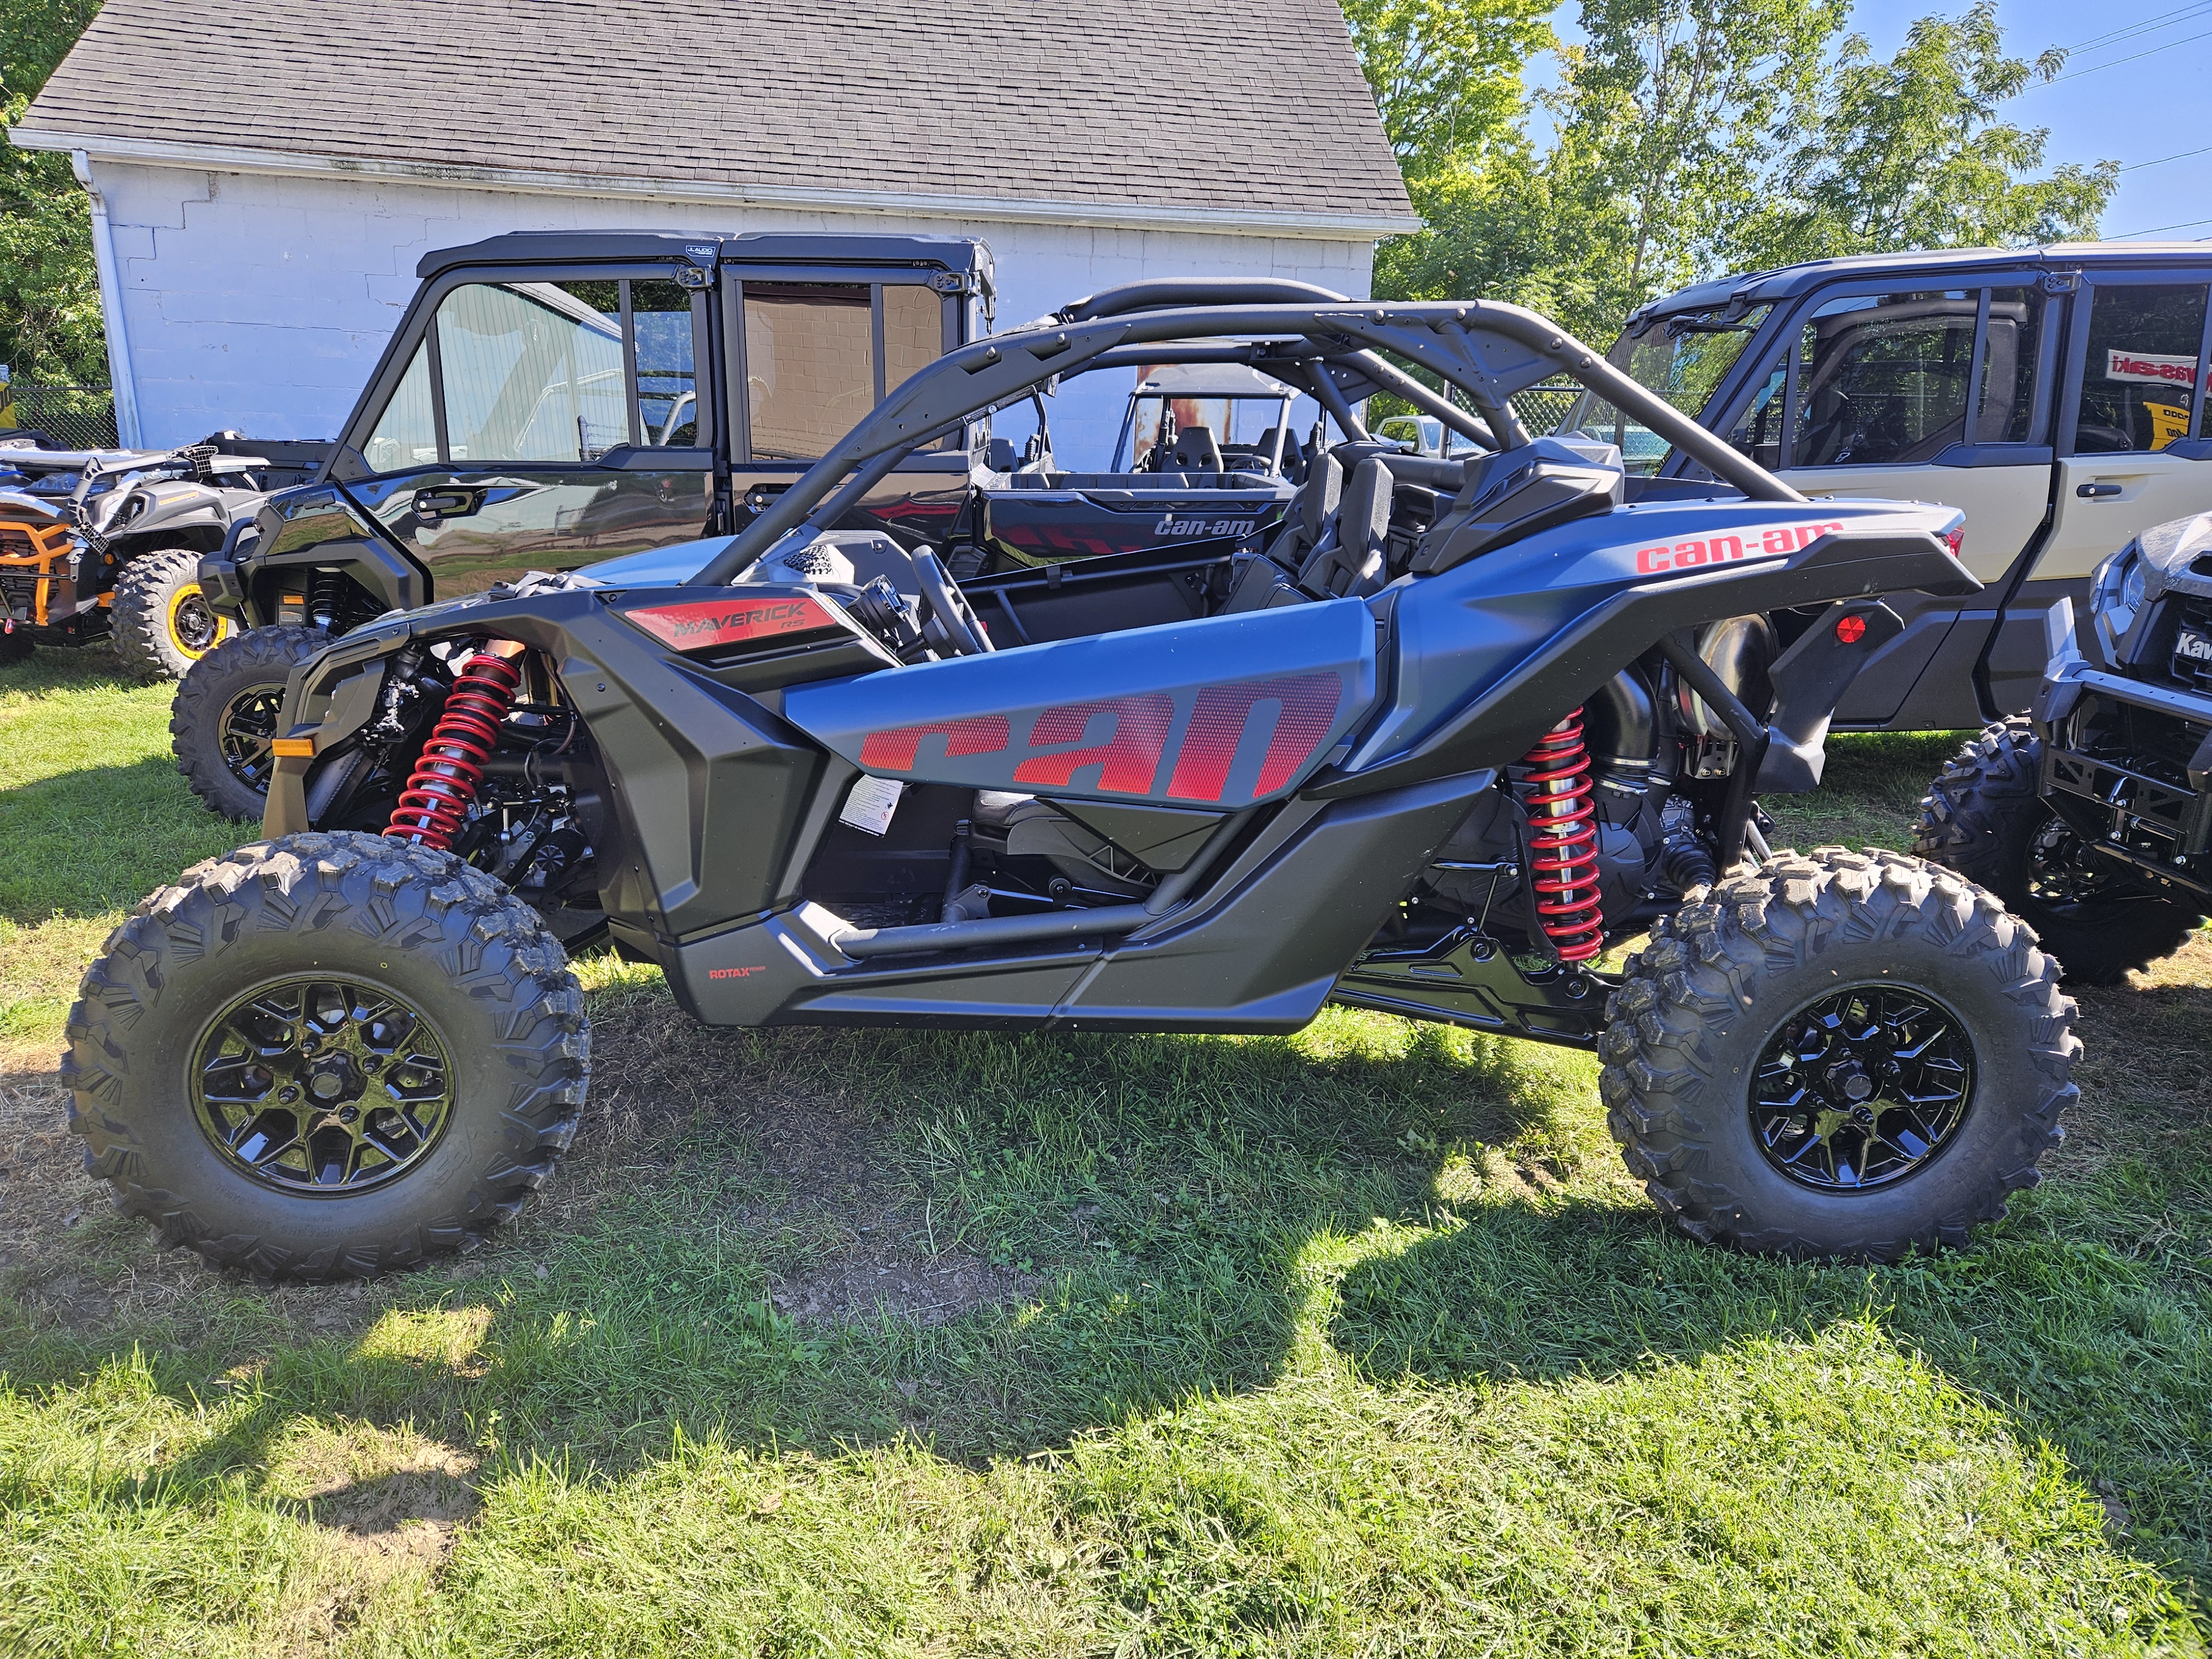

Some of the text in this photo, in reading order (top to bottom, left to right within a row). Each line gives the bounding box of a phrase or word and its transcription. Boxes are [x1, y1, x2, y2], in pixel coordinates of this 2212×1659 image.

[1154, 520, 1255, 535] can-am
[674, 602, 807, 637] MAVERICK
[780, 619, 805, 629] RS
[709, 968, 750, 979] ROTAX
